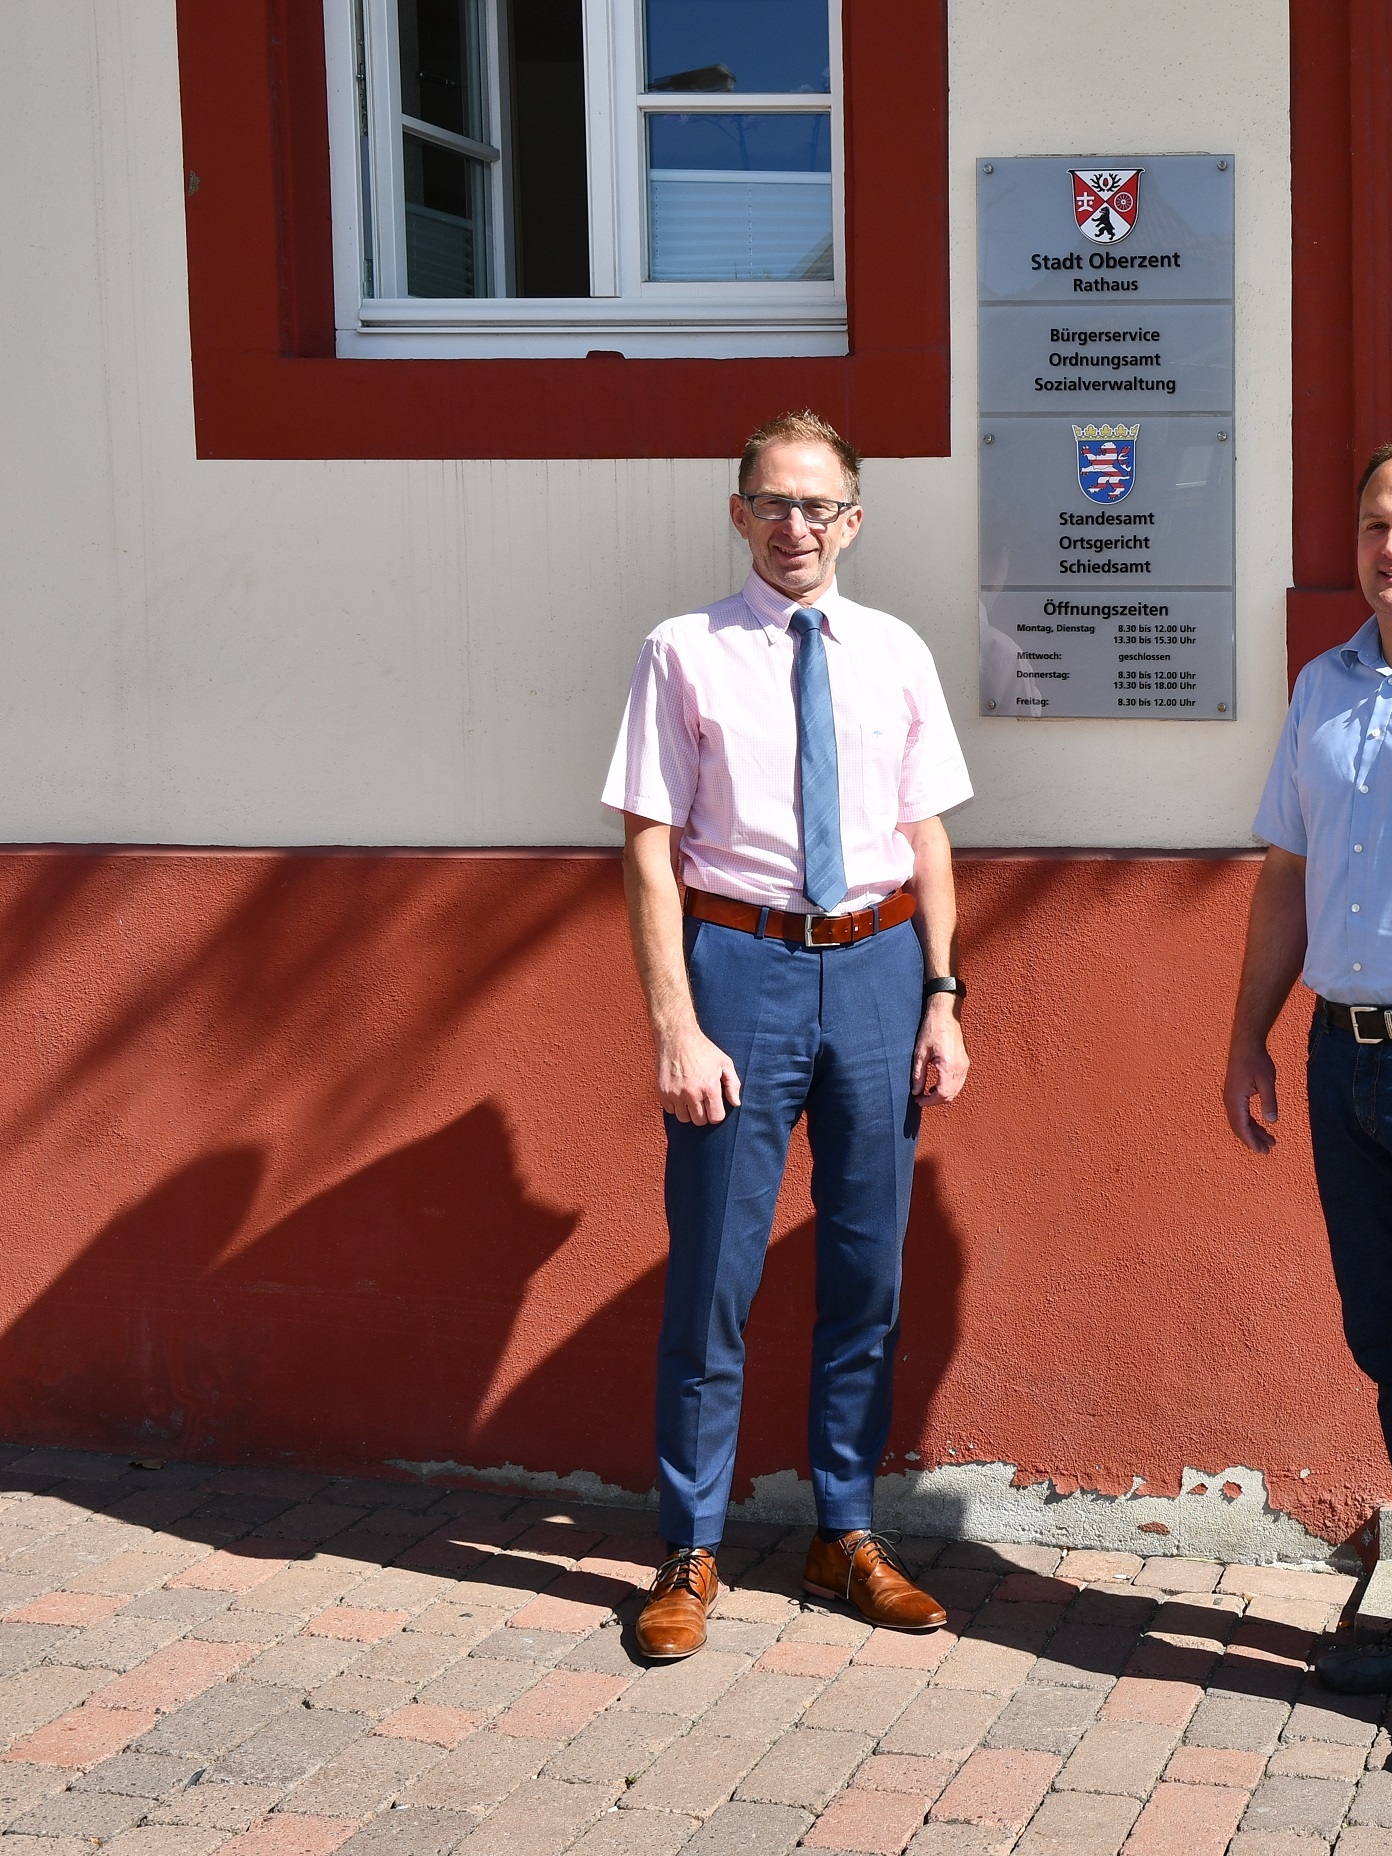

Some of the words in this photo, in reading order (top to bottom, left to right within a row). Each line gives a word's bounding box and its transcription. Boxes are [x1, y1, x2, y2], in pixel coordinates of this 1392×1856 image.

[1031, 253, 1083, 270] Stadt
[1088, 252, 1180, 269] Oberzent
[1073, 278, 1138, 292] Rathaus
[1050, 328, 1160, 345] Bürgerservice
[1048, 352, 1161, 369] Ordnungsamt
[1034, 376, 1176, 394] Sozialverwaltung
[1059, 511, 1154, 526] Standesamt
[1059, 535, 1150, 552] Ortsgericht
[1059, 560, 1151, 574] Schiedsamt
[1044, 600, 1169, 619] Öffnungszeiten
[1016, 624, 1054, 634] Montag,
[1056, 624, 1094, 634] Dienstag
[1118, 652, 1170, 662] geschlossen
[1016, 670, 1070, 680] Donnerstag:
[1139, 671, 1151, 679] bis
[1016, 698, 1048, 706] Freitag:
